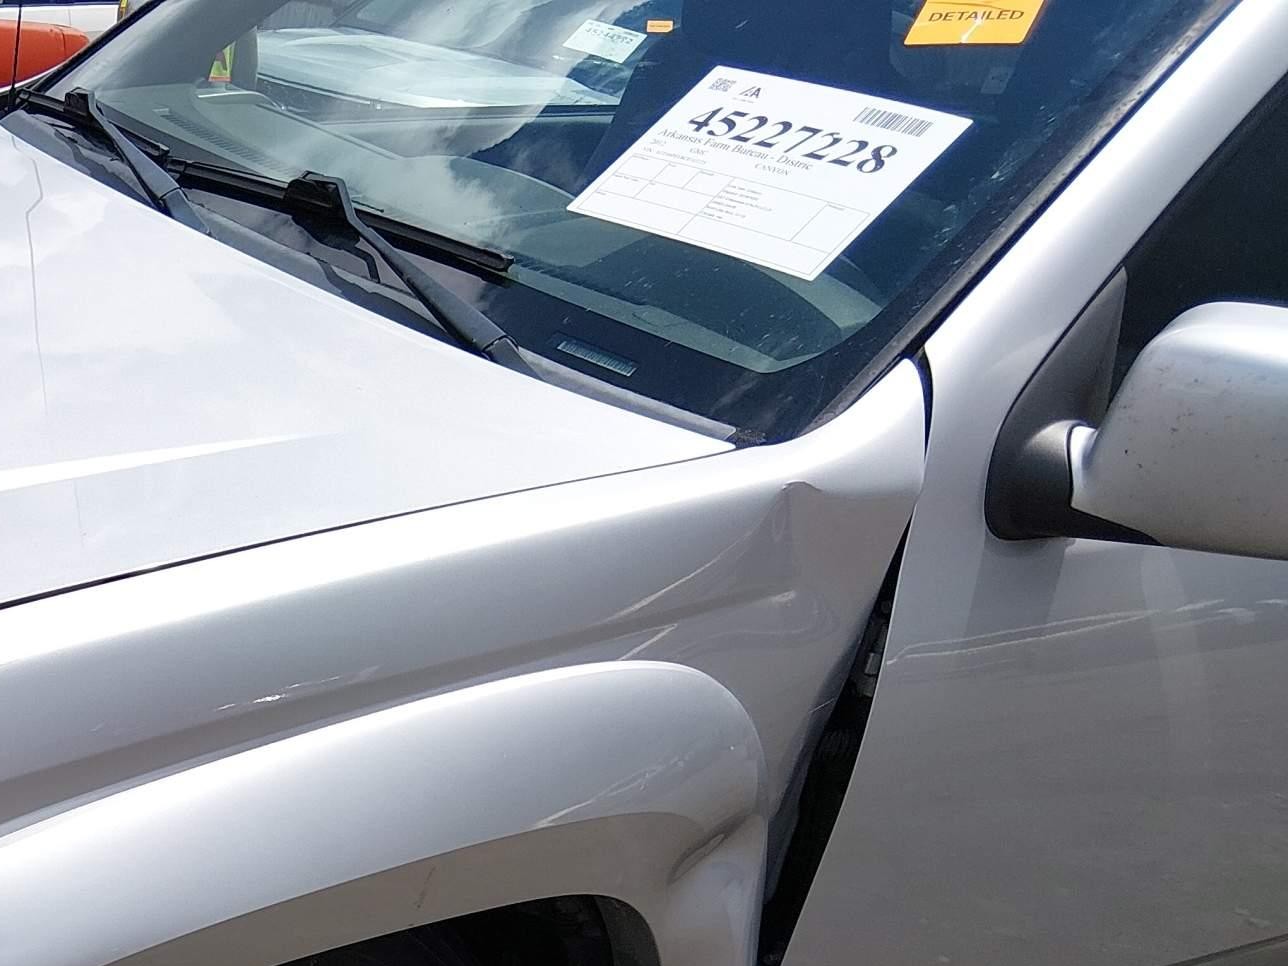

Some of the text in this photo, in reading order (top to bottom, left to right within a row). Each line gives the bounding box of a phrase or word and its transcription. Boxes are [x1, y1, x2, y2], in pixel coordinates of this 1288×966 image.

[928, 9, 1025, 22] DETAILED
[658, 128, 702, 144] Arkansas
[703, 137, 731, 151] Farm
[731, 144, 768, 160] Bureau
[688, 107, 898, 174] 45227228
[754, 163, 791, 177] CANYON
